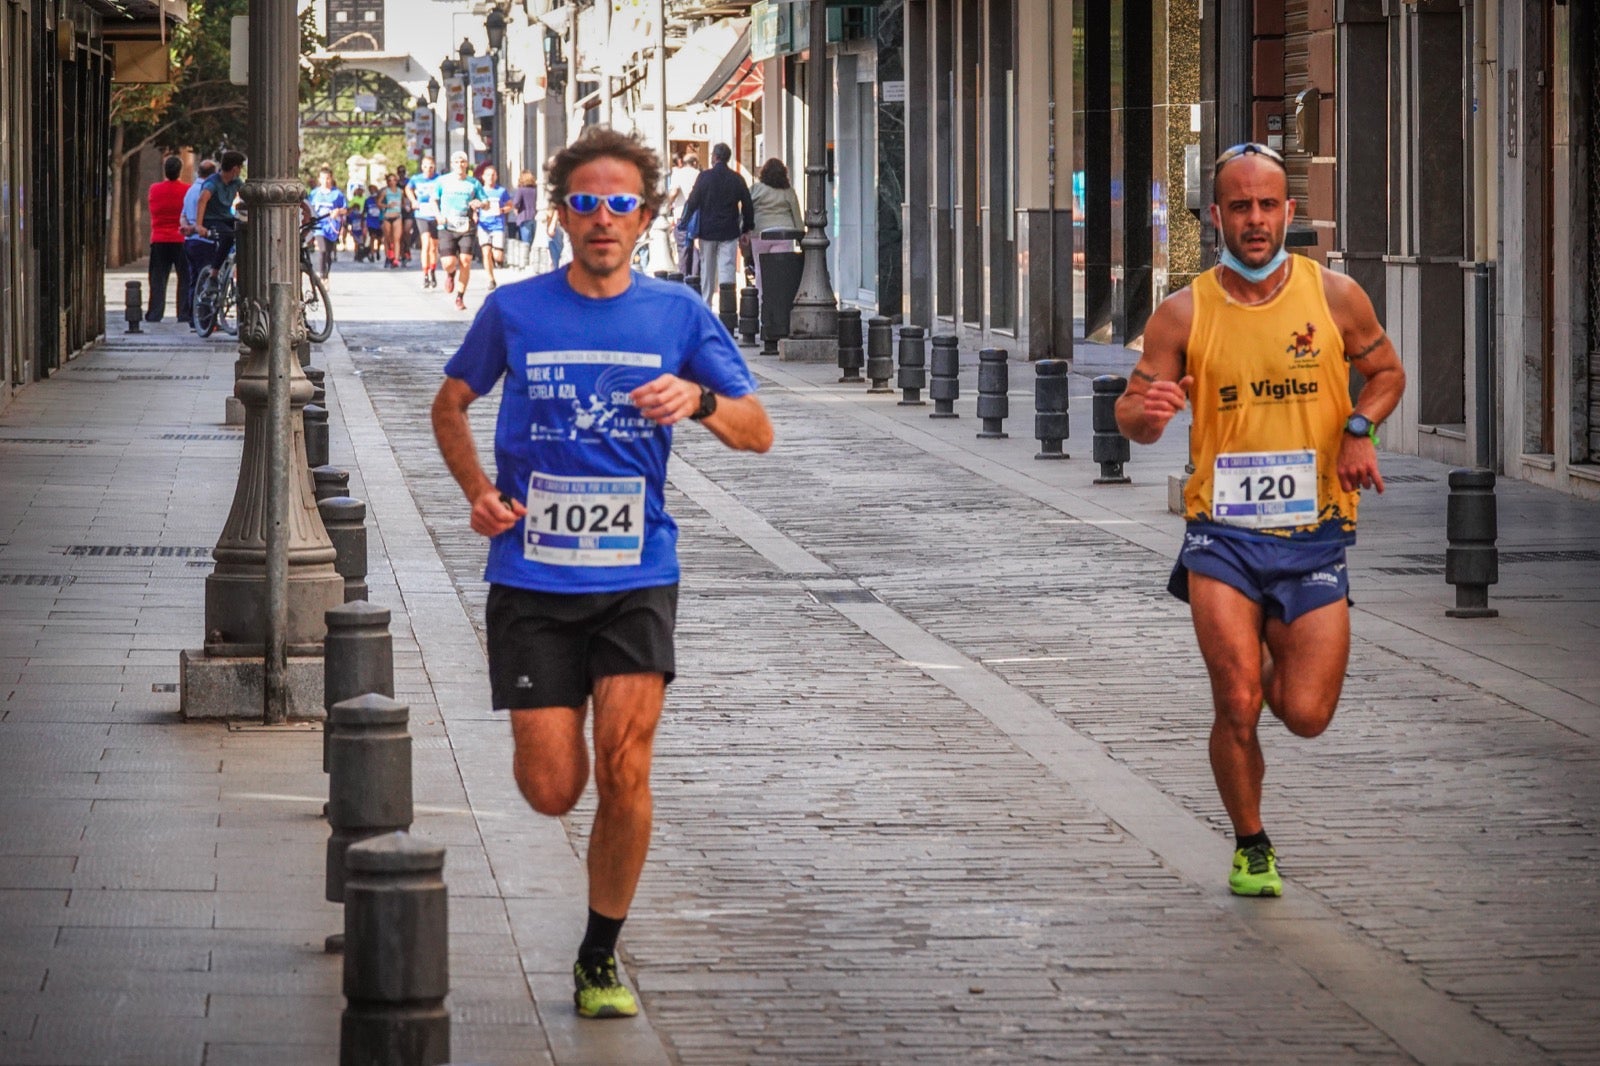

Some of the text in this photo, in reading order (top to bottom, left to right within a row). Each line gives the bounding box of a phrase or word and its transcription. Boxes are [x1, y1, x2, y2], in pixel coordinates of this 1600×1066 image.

[526, 366, 565, 382] VUELVE LA
[528, 384, 555, 400] ESTELA
[1250, 378, 1318, 399] Vigilsa
[1239, 474, 1296, 502] 120
[544, 503, 632, 533] 1024
